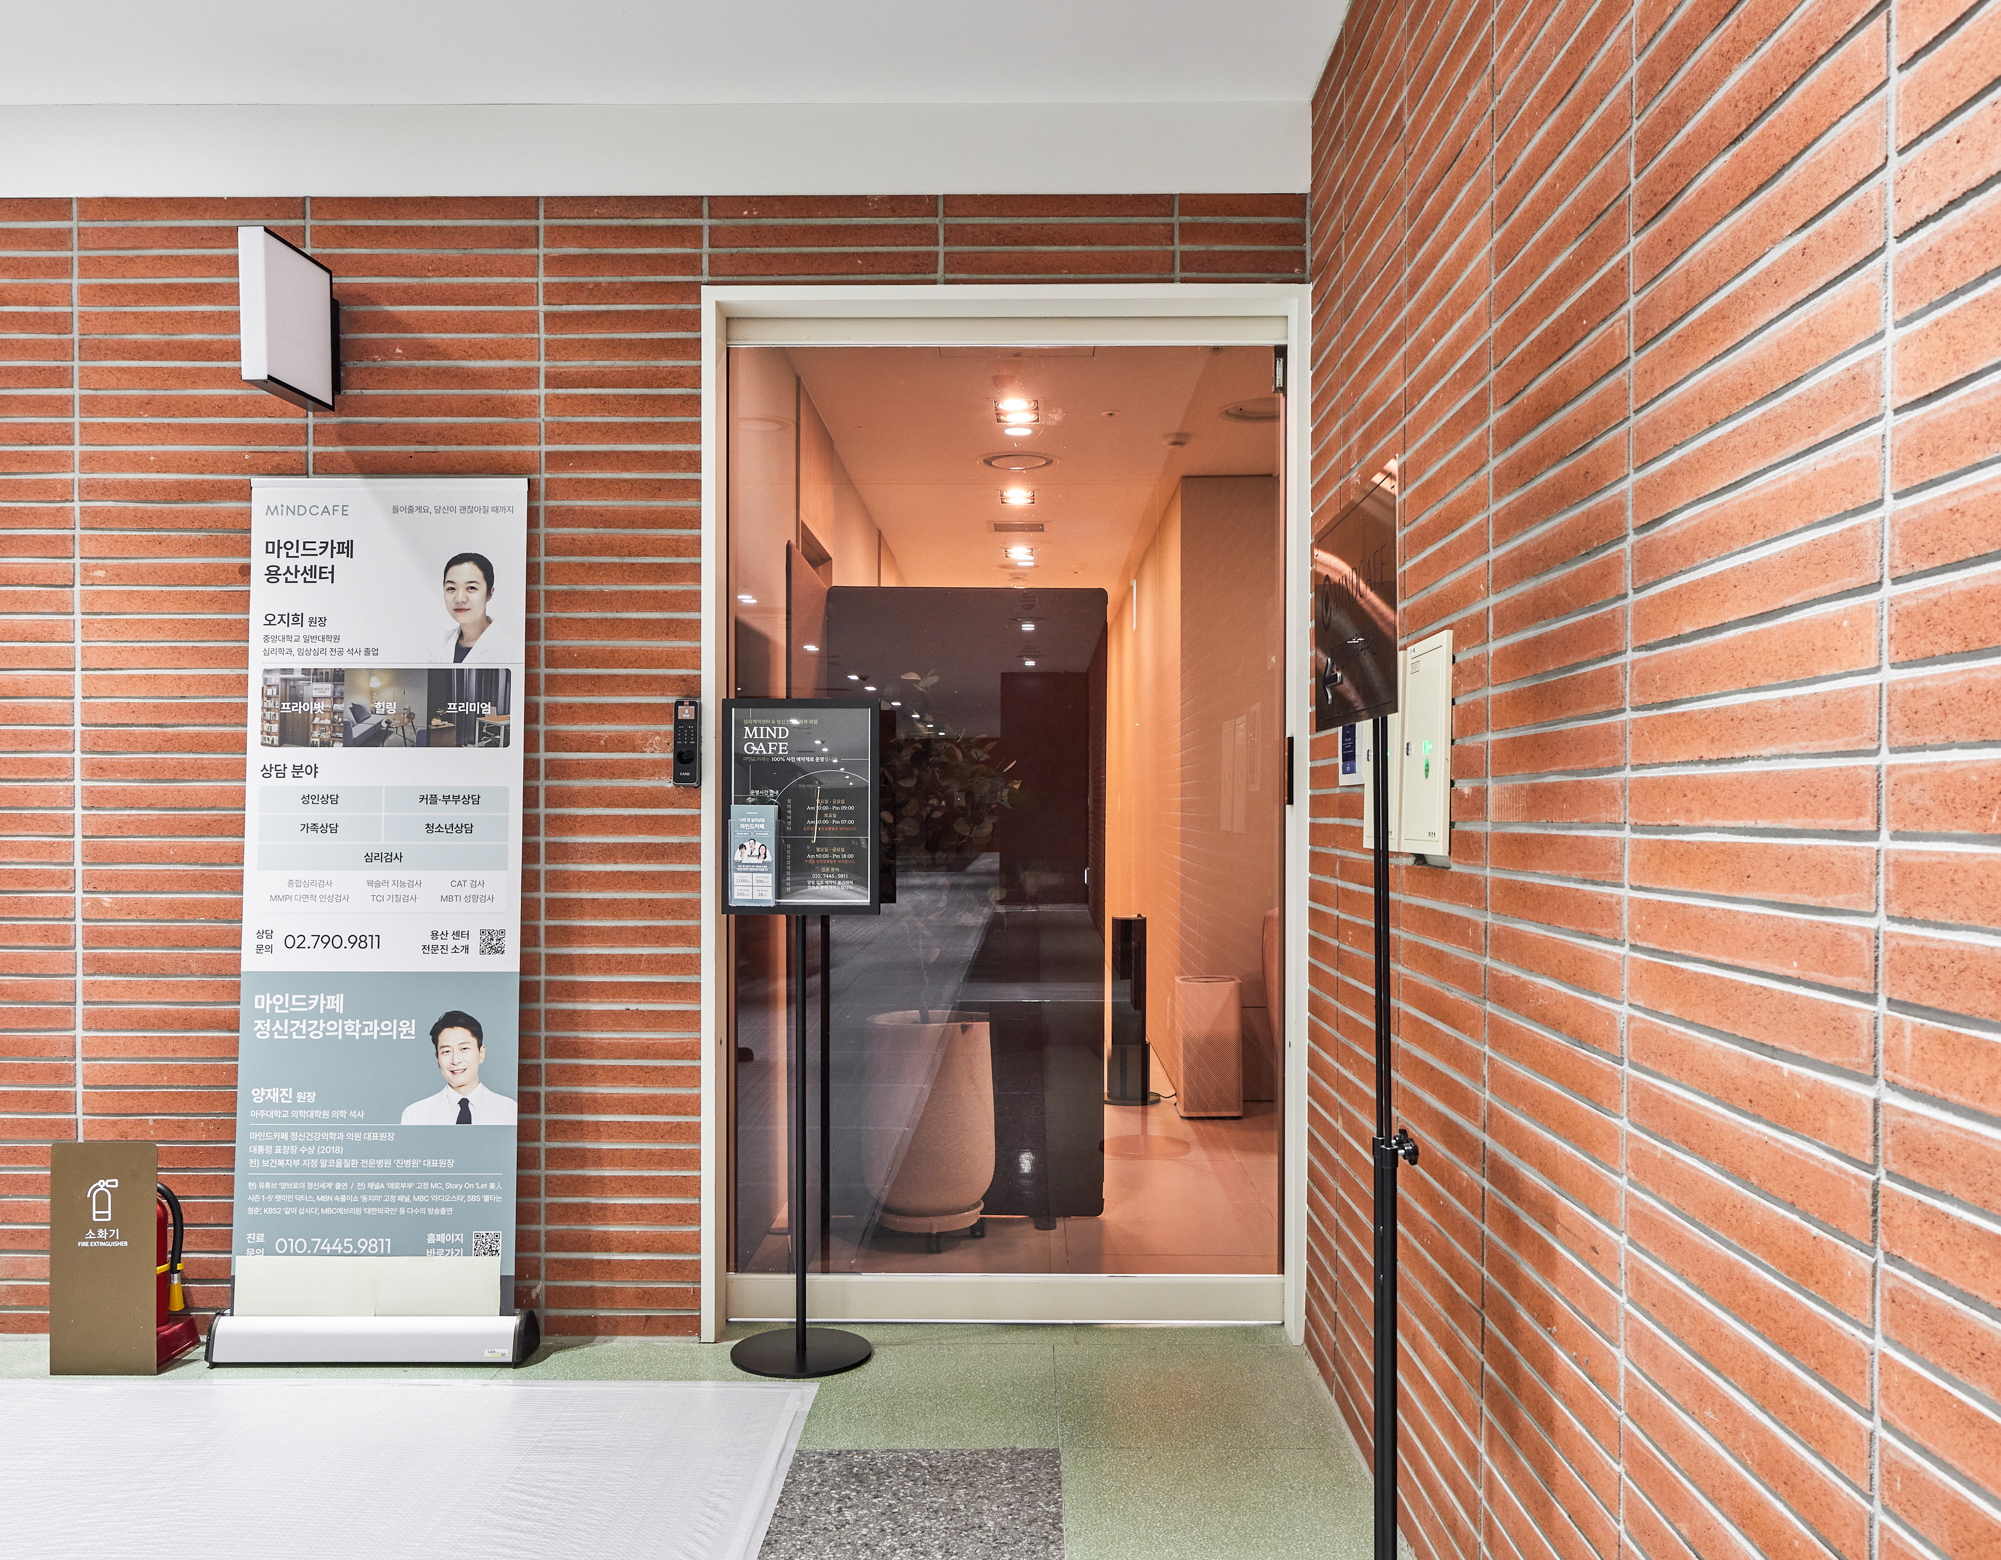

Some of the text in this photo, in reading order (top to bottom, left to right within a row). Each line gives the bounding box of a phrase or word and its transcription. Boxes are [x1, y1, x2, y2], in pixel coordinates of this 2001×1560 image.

[391, 505, 514, 515] 들어줄게요, 당신이 괜찮아질 때까지
[265, 539, 354, 559] 마인드카페
[264, 565, 335, 584] 용산센터
[263, 612, 327, 628] 오지희 원장
[262, 634, 341, 643] 중앙대학교 일반대학원
[262, 647, 379, 656] 심리학과, 임상심리 전공 석사 졸업
[280, 701, 325, 715] 프라이빗
[374, 701, 397, 715] 힐링
[446, 701, 491, 715] 프리미엄
[743, 726, 789, 739] MIND
[743, 742, 789, 755] CAFE
[260, 763, 319, 779] 상담 분야
[300, 794, 339, 805] 성인상담
[299, 822, 339, 834] 가족상담
[424, 822, 474, 834] 청소년상담
[363, 852, 403, 863] 심리검사
[287, 879, 333, 888] 종합심리검사
[366, 879, 422, 888] 웩슬러 지능검사
[450, 879, 485, 888] CAT 검사
[269, 894, 350, 903] MMPI 다면적 인성검사
[371, 894, 417, 903] TCI 기질검사
[440, 894, 494, 903] MBTI 성향검사
[255, 929, 274, 940] 상담
[430, 930, 470, 941] 용산 센터
[283, 934, 381, 950] 02.790.9811
[255, 944, 274, 954] 문의
[421, 944, 470, 955] 전문진 소개
[254, 993, 344, 1014] 마인드카페
[253, 1019, 416, 1040] 정신건강의학과의원
[251, 1087, 316, 1103] 양재진 원장
[250, 1109, 364, 1119] 아주대학교 의학대학원 의학 석사
[249, 1132, 395, 1141] 마인드카페 정신건강의학과 의원 대표원장
[249, 1145, 344, 1154] 대통령 표창장 수상 (2018)
[248, 1159, 260, 1168] 전)
[261, 1159, 300, 1168] 보건복지부
[302, 1159, 318, 1168] 지정
[319, 1159, 358, 1168] 알코올질환
[360, 1159, 392, 1168] 전문병원
[422, 1159, 455, 1168] 대표원장
[430, 1182, 444, 1190] MC,
[445, 1182, 463, 1190] Story
[464, 1182, 475, 1190] On
[316, 1195, 333, 1203] MBN
[412, 1195, 429, 1203] MBC
[466, 1195, 481, 1203] SBS
[263, 1207, 282, 1215] KBS2
[407, 1207, 426, 1215] 다수의
[84, 1228, 120, 1240] 소화기
[246, 1233, 265, 1244] 진료
[426, 1233, 464, 1244] 홈페이지
[275, 1238, 392, 1254] 010.7445.9811
